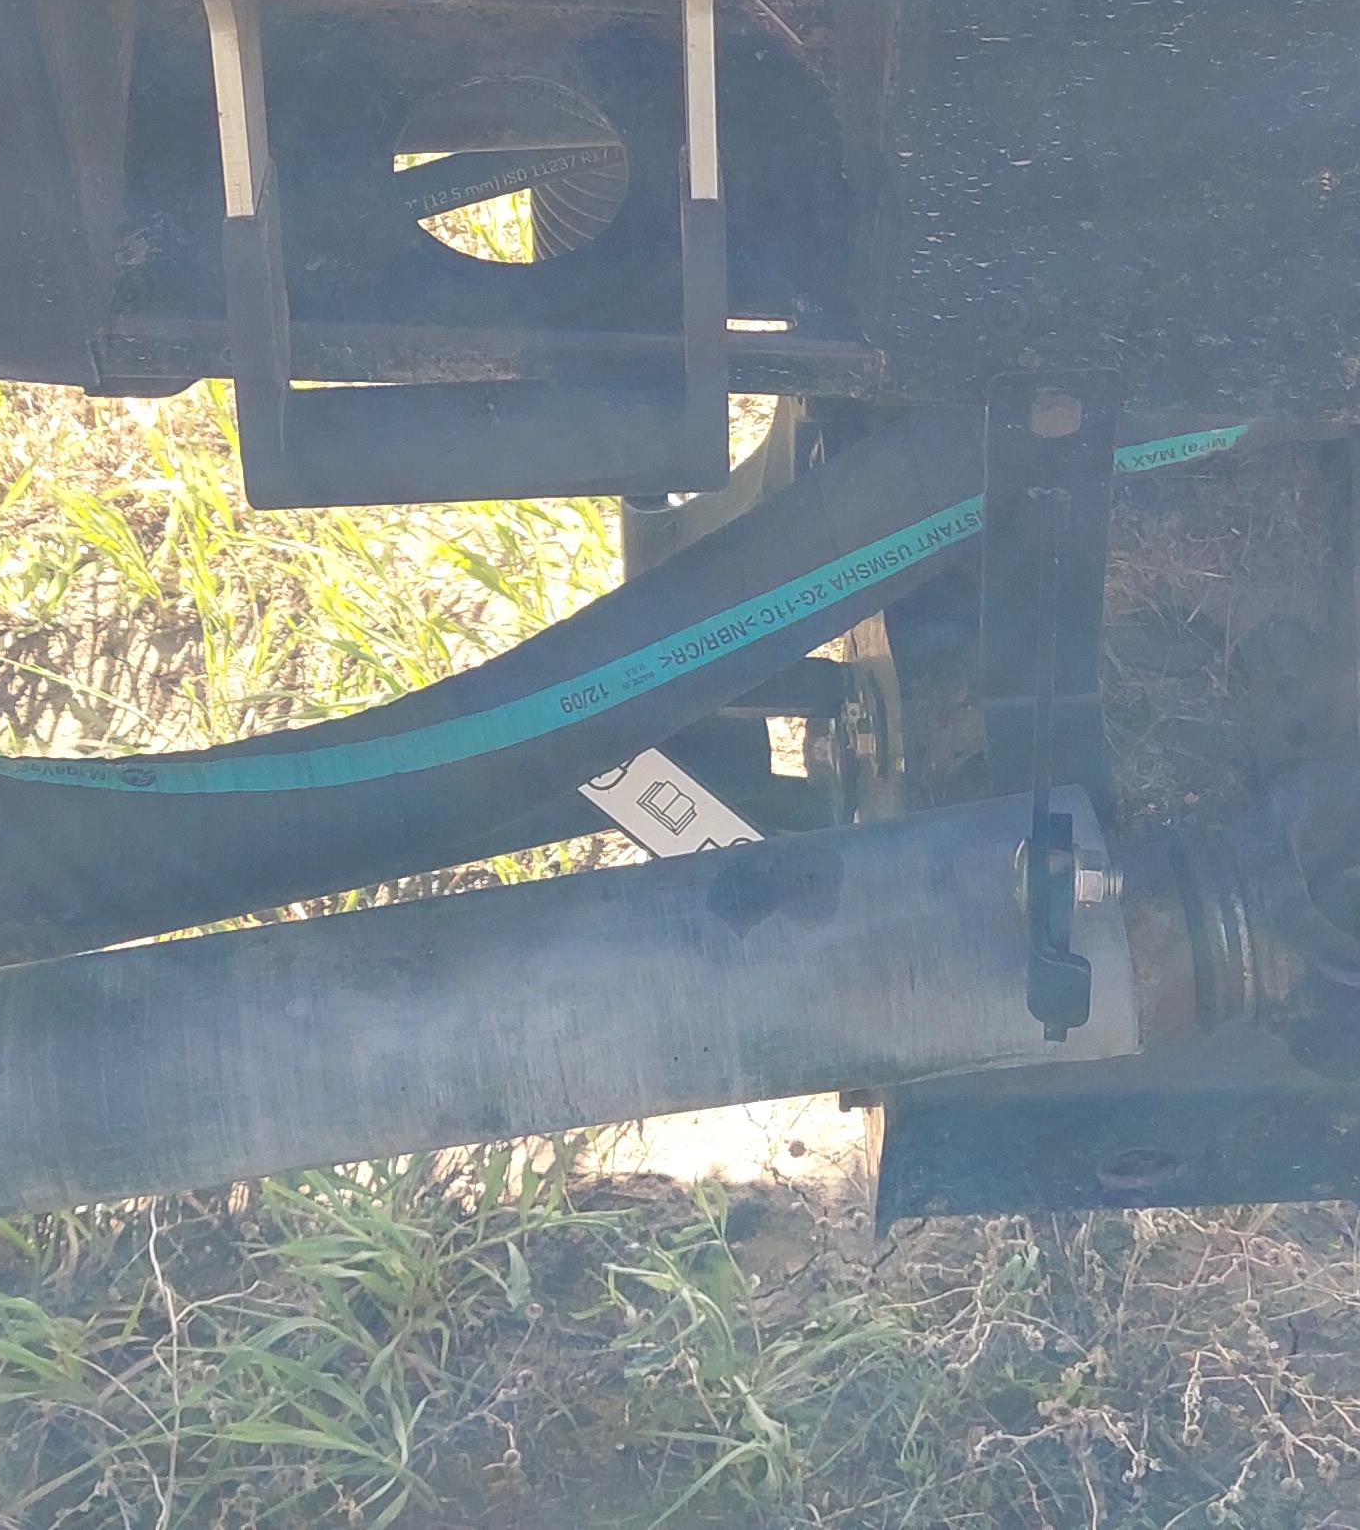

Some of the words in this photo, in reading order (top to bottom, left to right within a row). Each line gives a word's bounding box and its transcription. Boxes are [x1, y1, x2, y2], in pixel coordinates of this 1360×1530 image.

[503, 168, 528, 186] ISO
[531, 154, 576, 178] 11237
[1130, 447, 1177, 468] MAX
[827, 544, 914, 592] USMSHA
[759, 583, 828, 625] 2G-11C
[559, 681, 611, 714] 12/09
